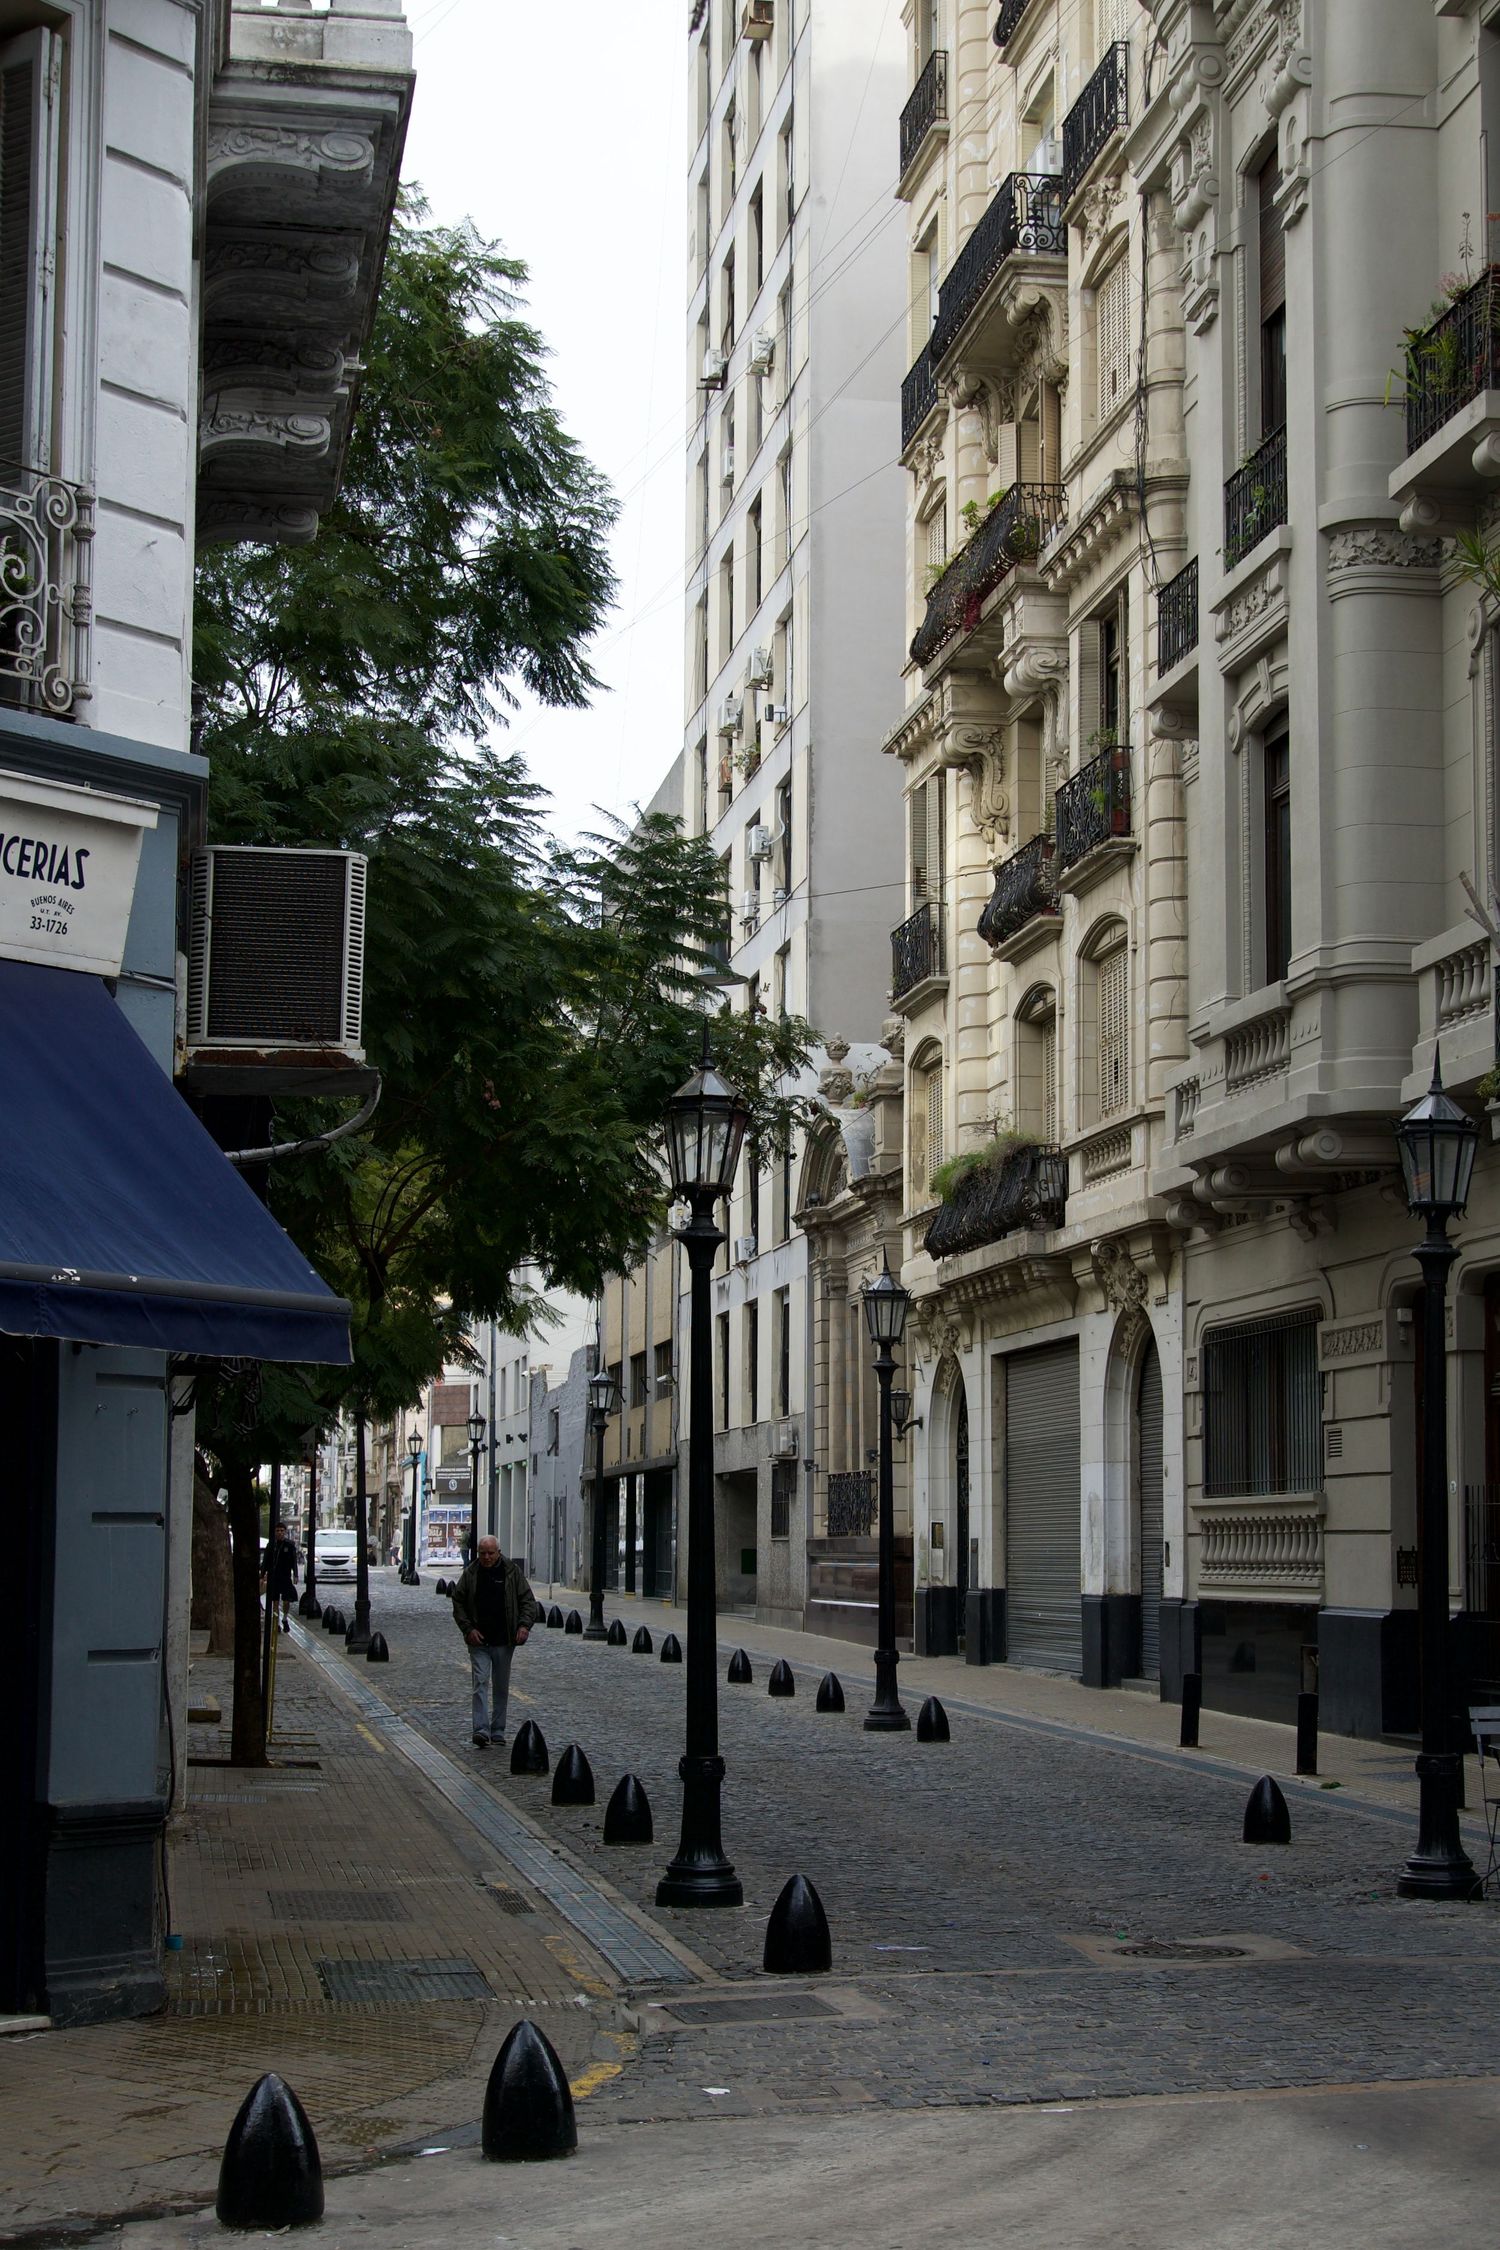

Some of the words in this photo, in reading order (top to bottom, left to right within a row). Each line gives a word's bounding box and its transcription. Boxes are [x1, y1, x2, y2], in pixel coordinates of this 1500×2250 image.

[30, 895, 57, 908] BUENOS
[58, 898, 75, 915] AIRES
[29, 915, 68, 935] 33-1726
